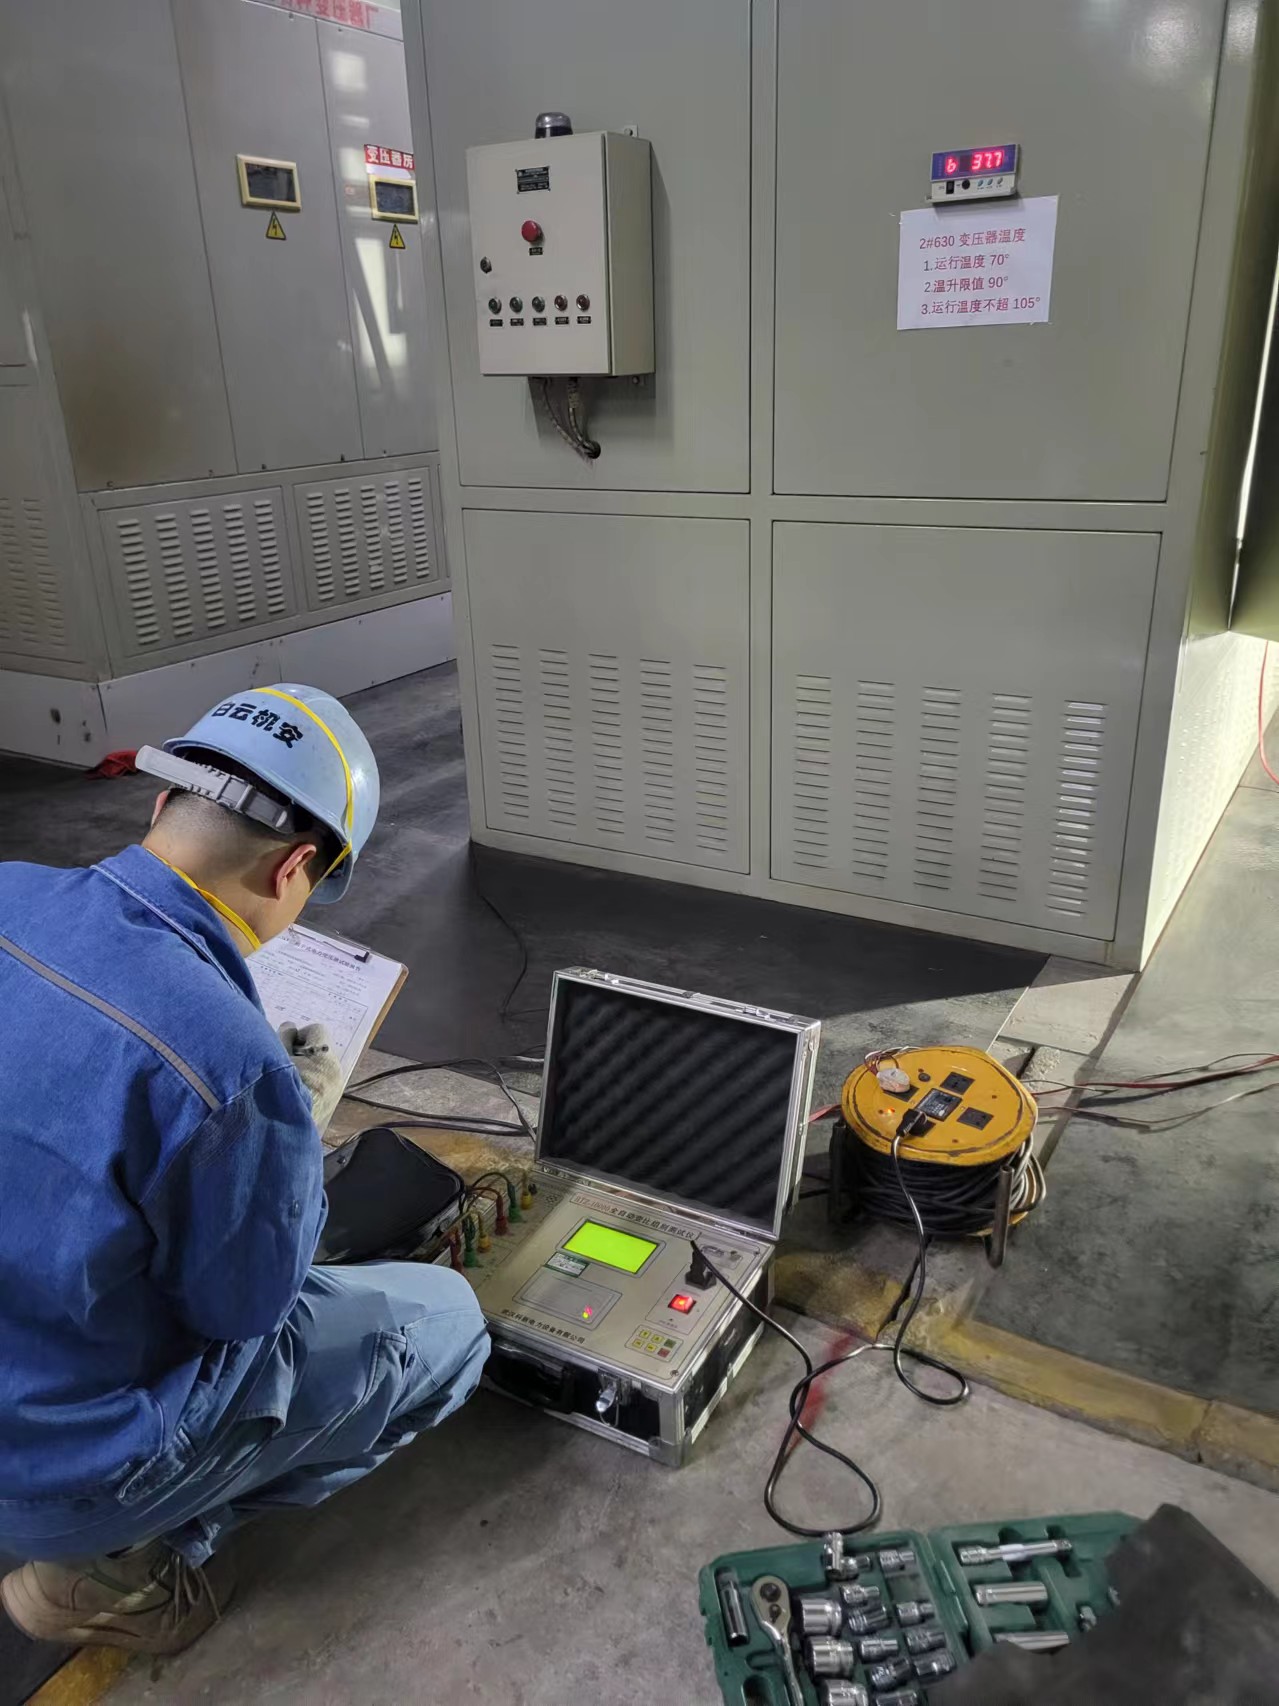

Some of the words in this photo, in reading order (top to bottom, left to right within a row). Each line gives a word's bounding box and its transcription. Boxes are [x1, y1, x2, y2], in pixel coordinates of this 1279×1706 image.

[919, 235, 955, 249] 2#630
[959, 228, 1026, 248] 变压器温度
[923, 254, 986, 272] 1.运行温度
[923, 276, 985, 293] 2.温升限值
[921, 297, 1009, 315] 3.运行温度不超
